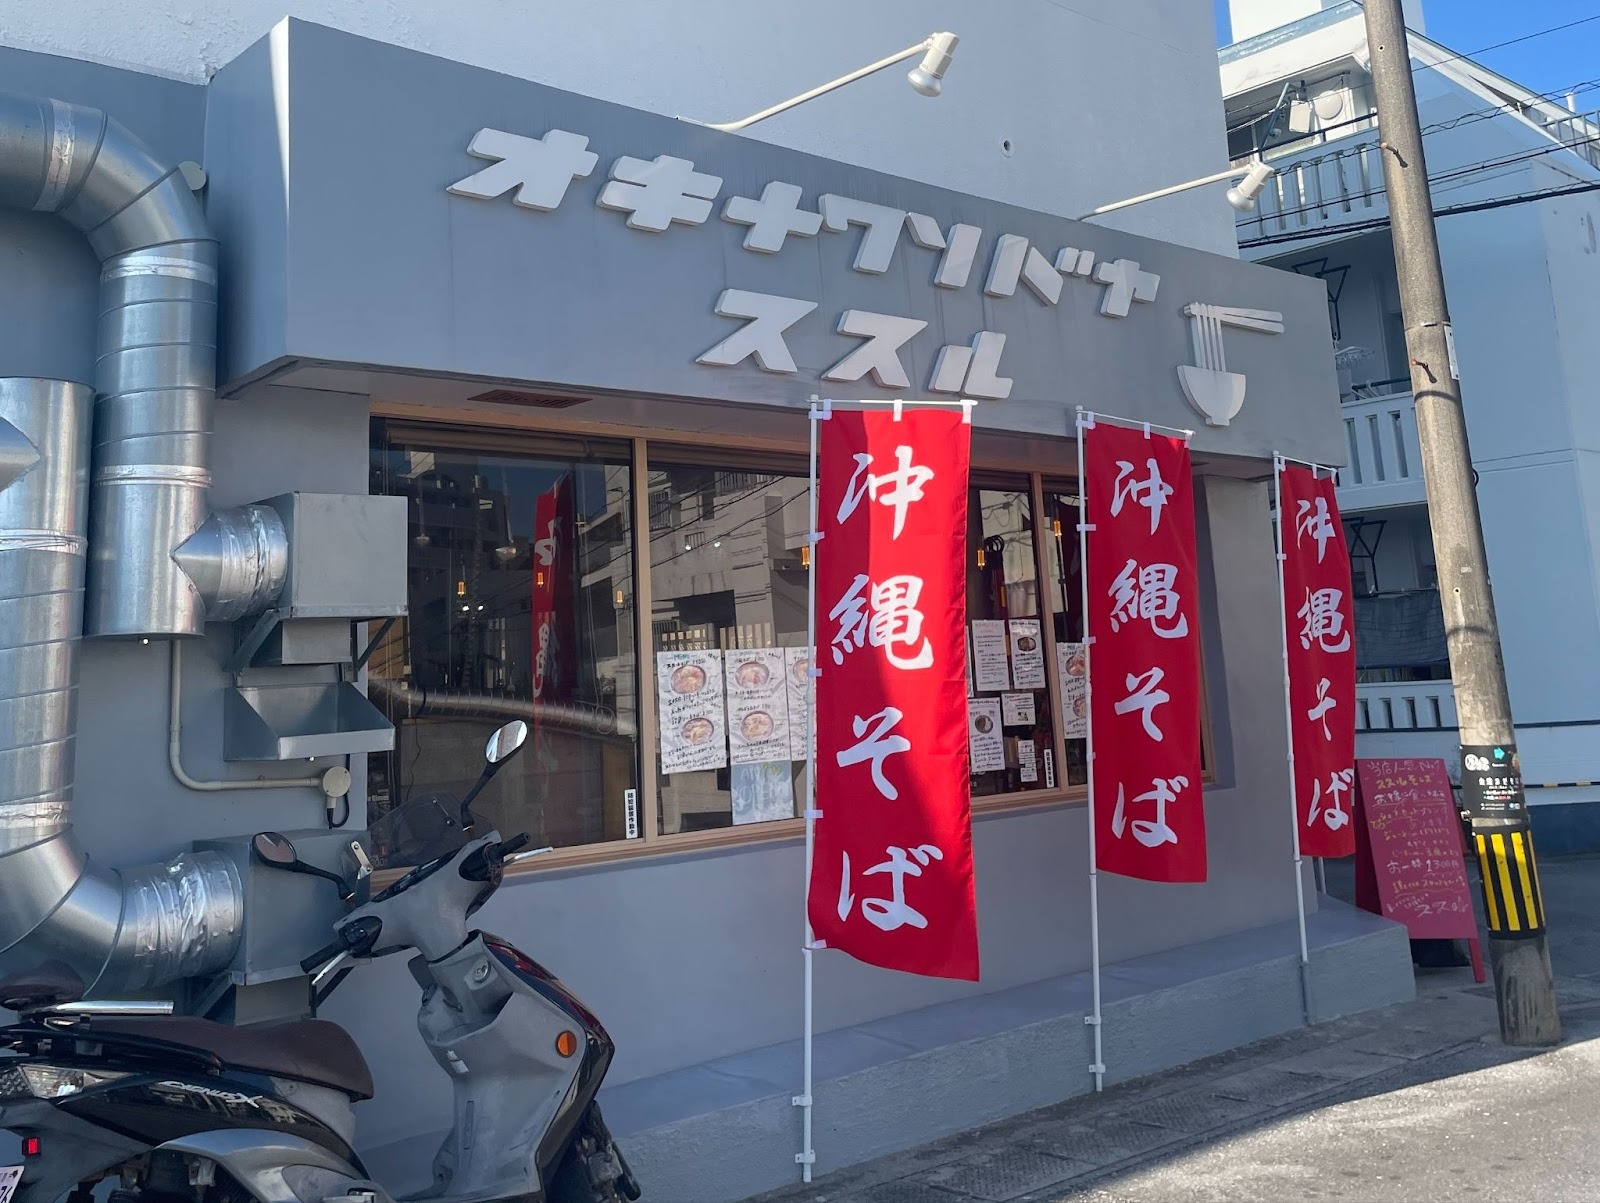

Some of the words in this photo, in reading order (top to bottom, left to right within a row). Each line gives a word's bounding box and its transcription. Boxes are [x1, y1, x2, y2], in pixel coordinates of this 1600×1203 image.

[446, 127, 1160, 318] オキナワソバヤ
[695, 288, 1014, 399] ススル
[829, 445, 943, 931] 沖縄そば
[1108, 457, 1188, 847] 沖縄そば
[1296, 497, 1354, 830] 沖縄そば
